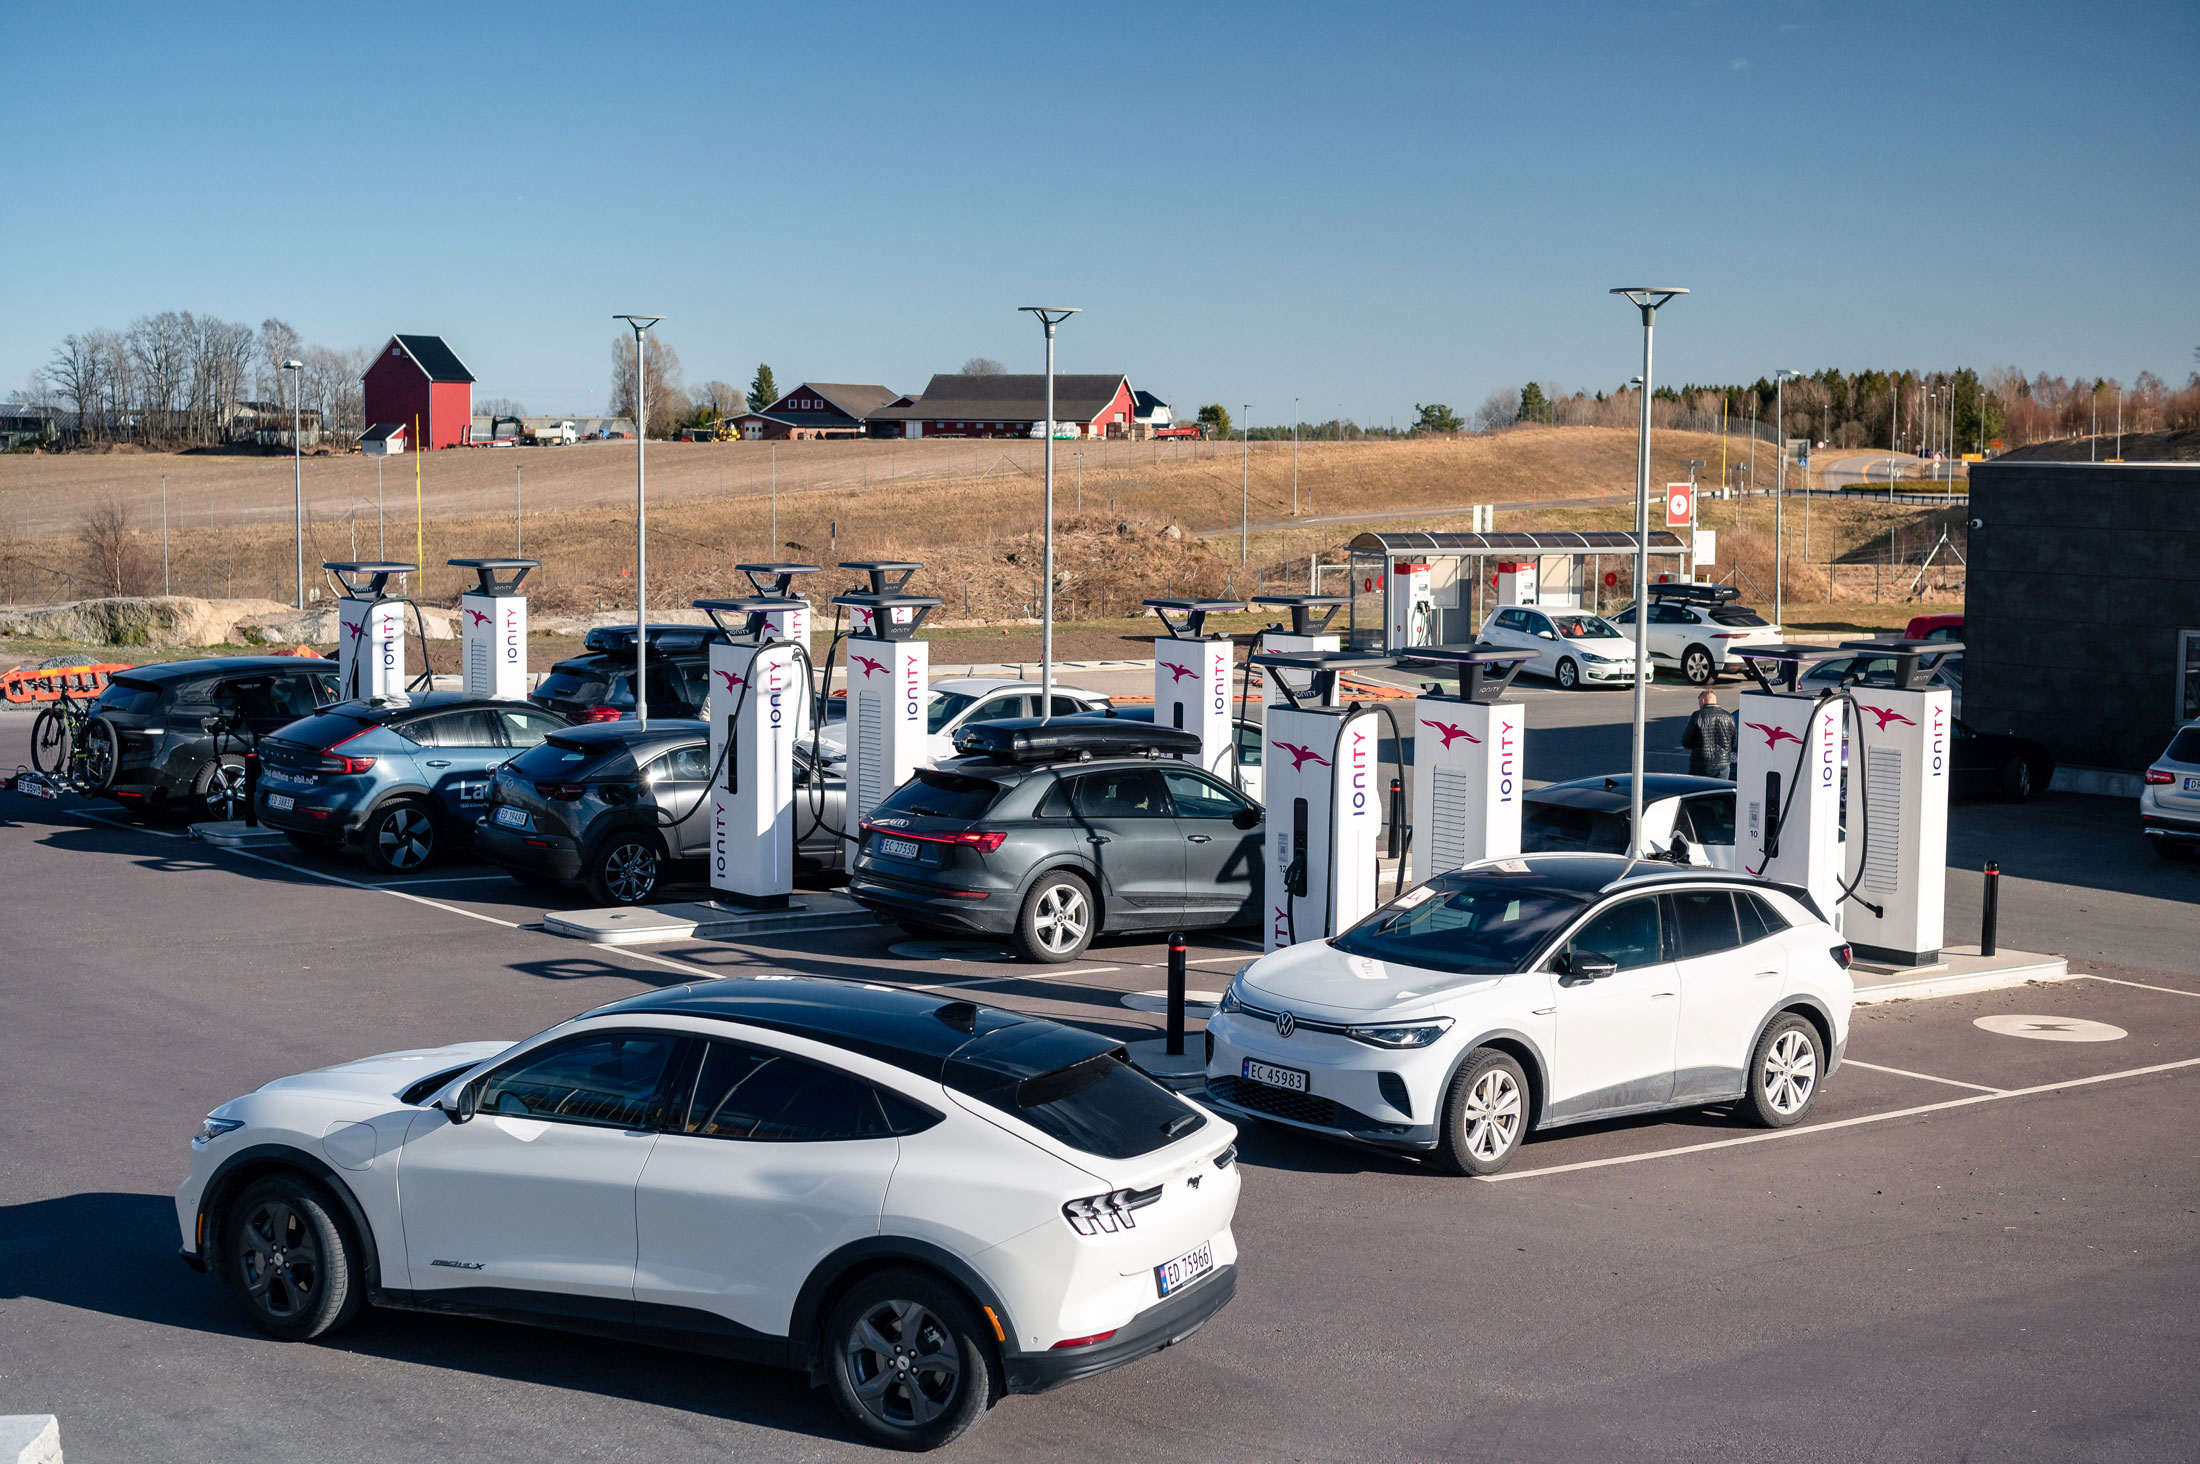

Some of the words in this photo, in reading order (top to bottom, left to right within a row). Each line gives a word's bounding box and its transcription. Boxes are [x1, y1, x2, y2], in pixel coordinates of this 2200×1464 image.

[383, 613, 394, 671] IONITY
[507, 608, 517, 664] IONITY
[769, 661, 781, 729] IONITY
[907, 655, 918, 721] IONITY
[1214, 654, 1225, 716] IONITY
[1479, 686, 1500, 694] IONITY
[1500, 720, 1514, 803] IONITY
[1823, 714, 1834, 788] IONITY
[1933, 706, 1943, 777] IONITY
[1353, 731, 1366, 817] IONITY
[716, 803, 726, 878] IONITY
[884, 840, 894, 851] EC
[894, 842, 916, 857] 27550
[1749, 830, 1759, 838] 10
[1279, 865, 1287, 873] 12
[1251, 1064, 1263, 1080] EC
[1267, 1068, 1302, 1089] 45983
[1167, 1263, 1180, 1286] ED
[1181, 1245, 1210, 1276] 75966
